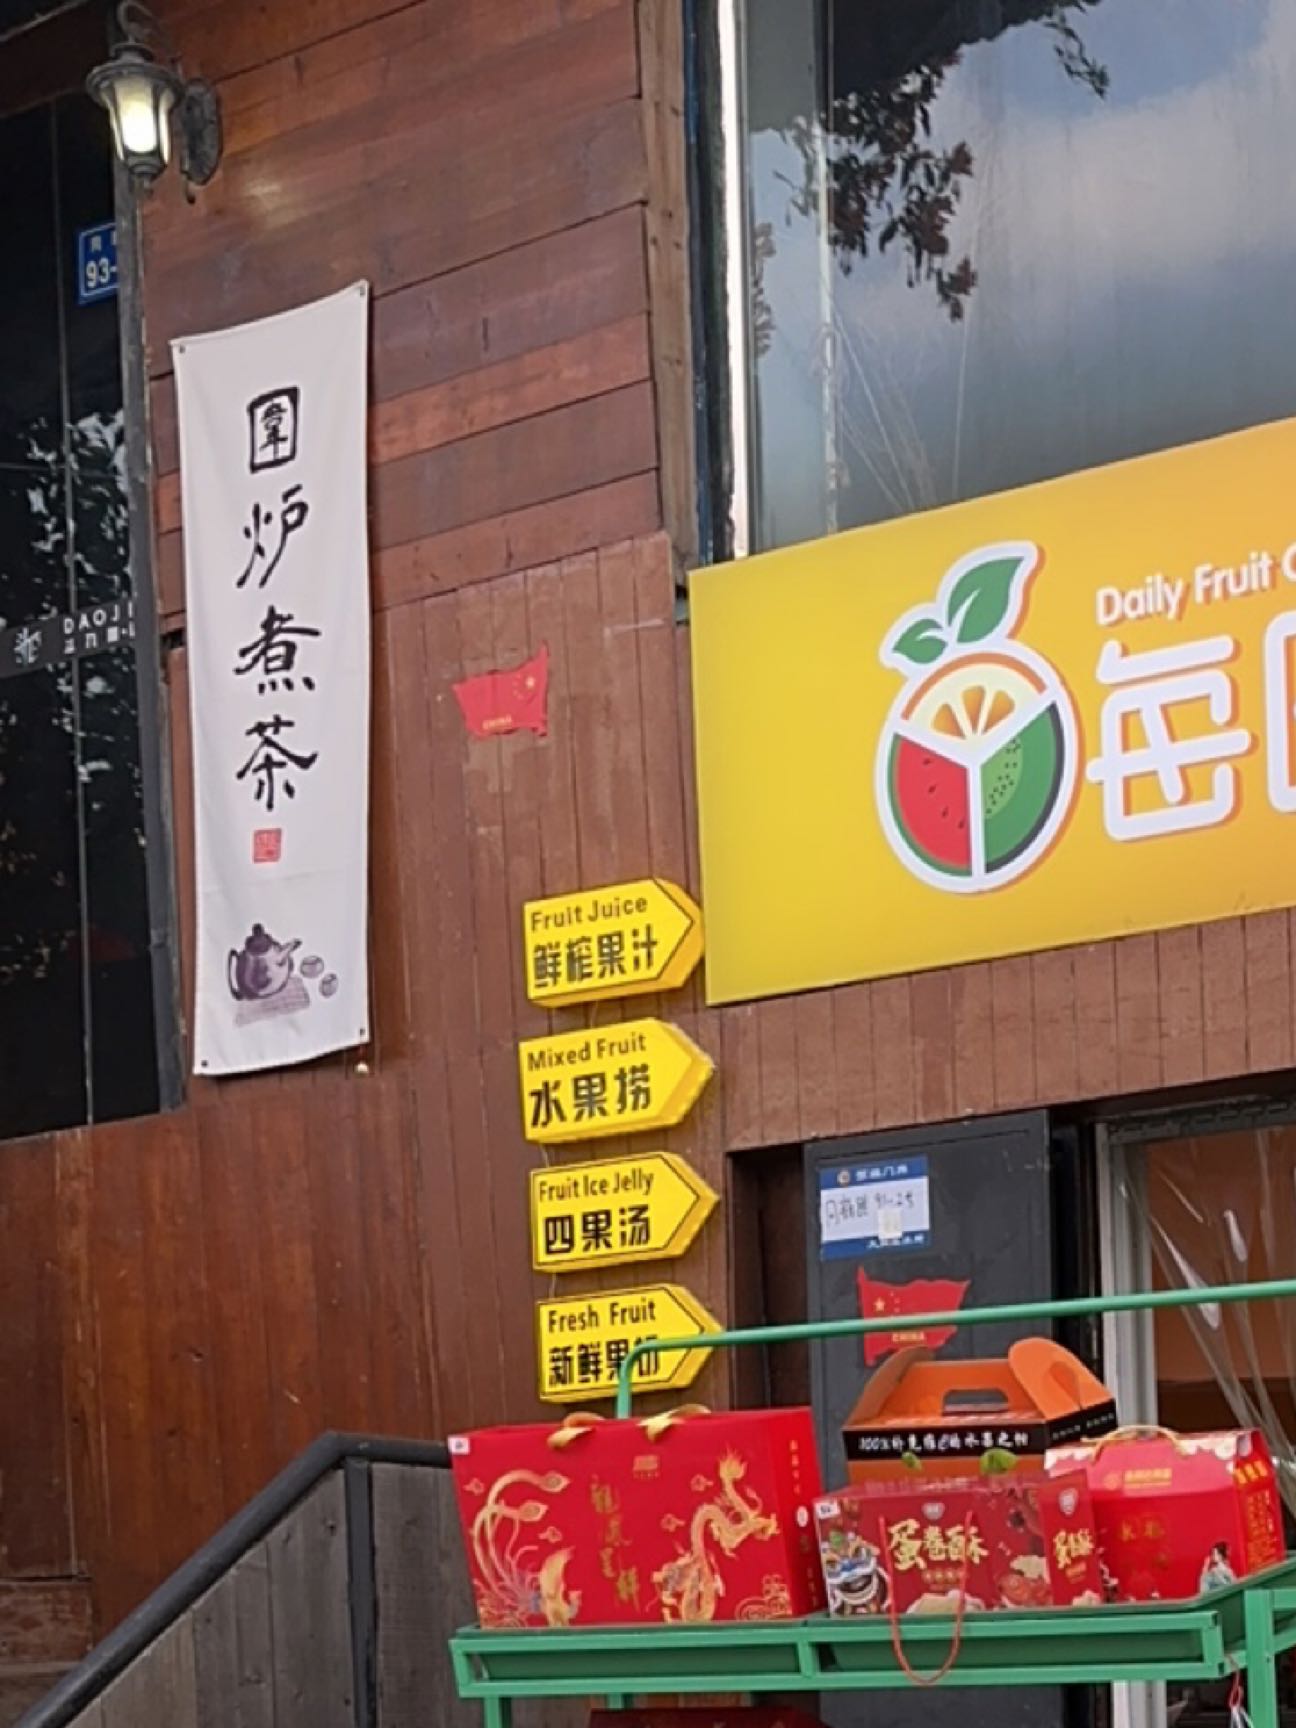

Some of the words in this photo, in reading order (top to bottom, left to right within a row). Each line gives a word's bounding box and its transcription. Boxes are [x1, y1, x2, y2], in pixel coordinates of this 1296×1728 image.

[1095, 573, 1183, 626] Daily
[1194, 551, 1273, 604] Fruit
[530, 905, 583, 932] Fruit
[588, 897, 648, 923] Juice
[533, 923, 658, 989] 鲜榨果汁
[527, 1042, 592, 1072] Mixed
[597, 1032, 647, 1060] Fruit
[528, 1063, 651, 1129] 水果捞
[539, 1177, 580, 1202] Fruit
[583, 1175, 607, 1197] Ice
[613, 1168, 654, 1196] Jelly
[545, 1203, 650, 1256] 四果汤
[548, 1305, 599, 1334] Fresh
[610, 1297, 656, 1326] Fruit
